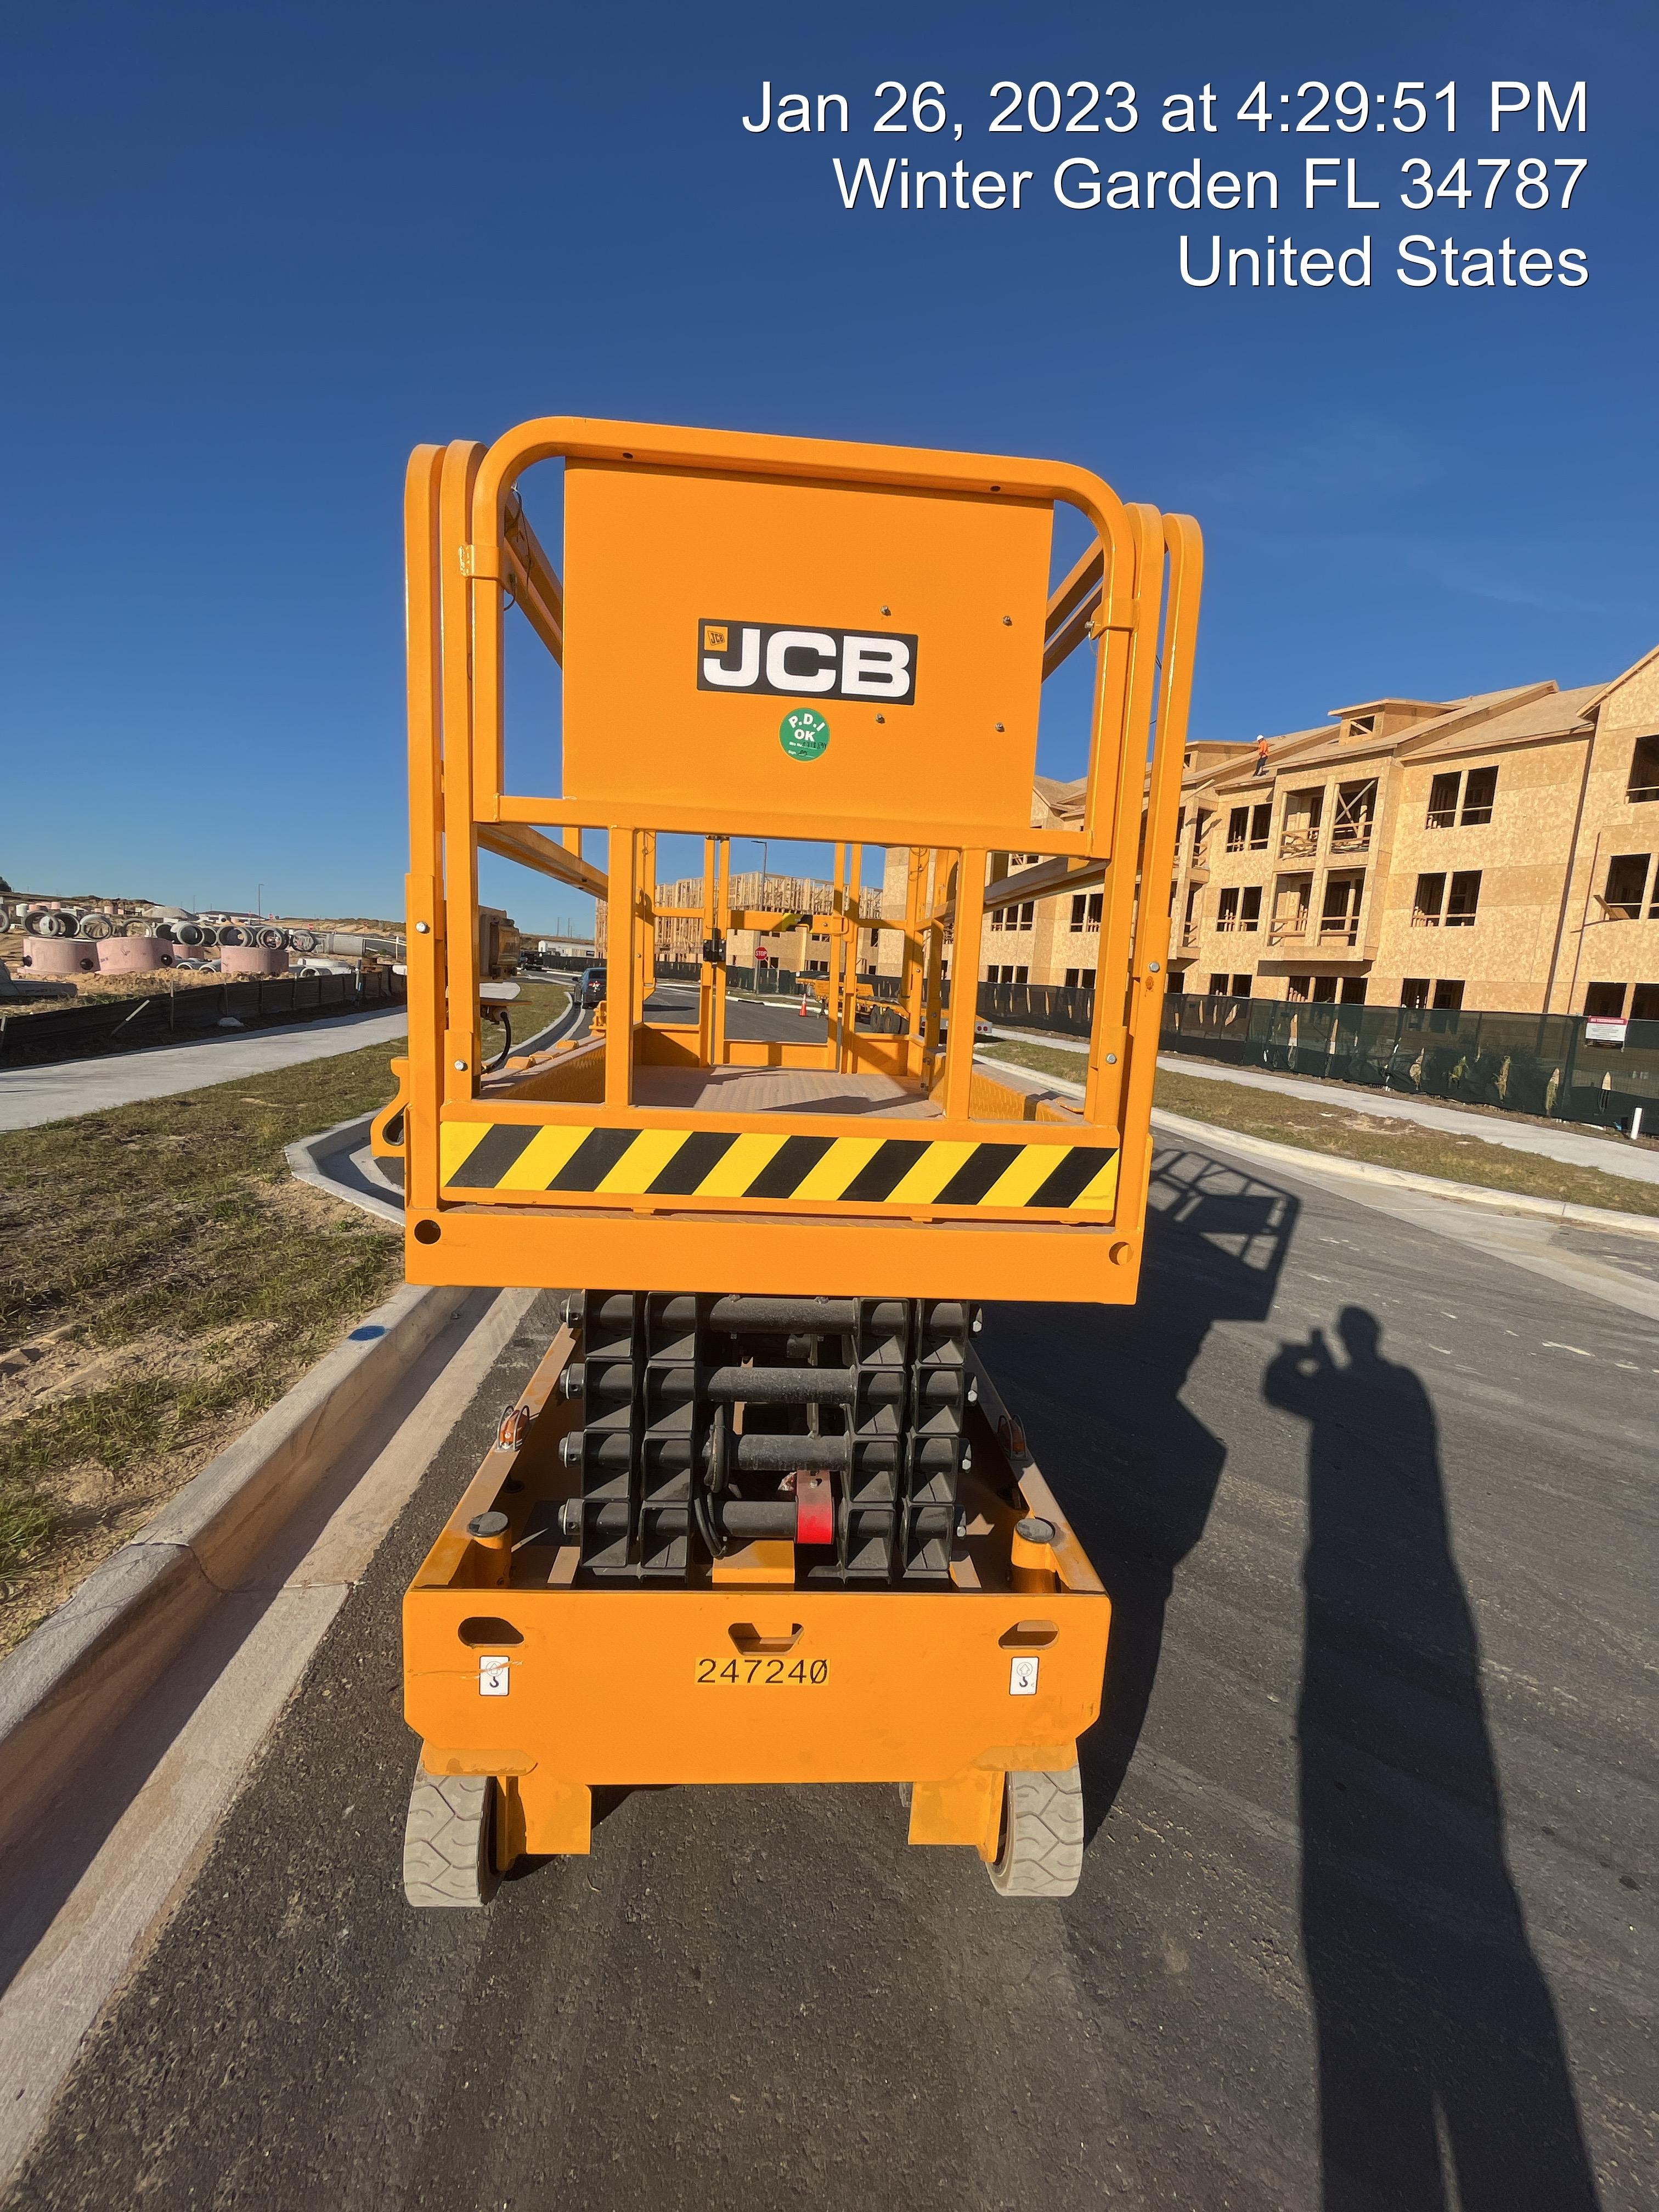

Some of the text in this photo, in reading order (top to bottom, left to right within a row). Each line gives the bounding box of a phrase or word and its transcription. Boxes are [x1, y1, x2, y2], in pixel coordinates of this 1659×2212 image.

[710, 633, 724, 644] JCB
[703, 628, 910, 697] JCB
[788, 713, 825, 732] P.D.I
[794, 729, 816, 742] OK
[697, 1658, 828, 1684] 247240
